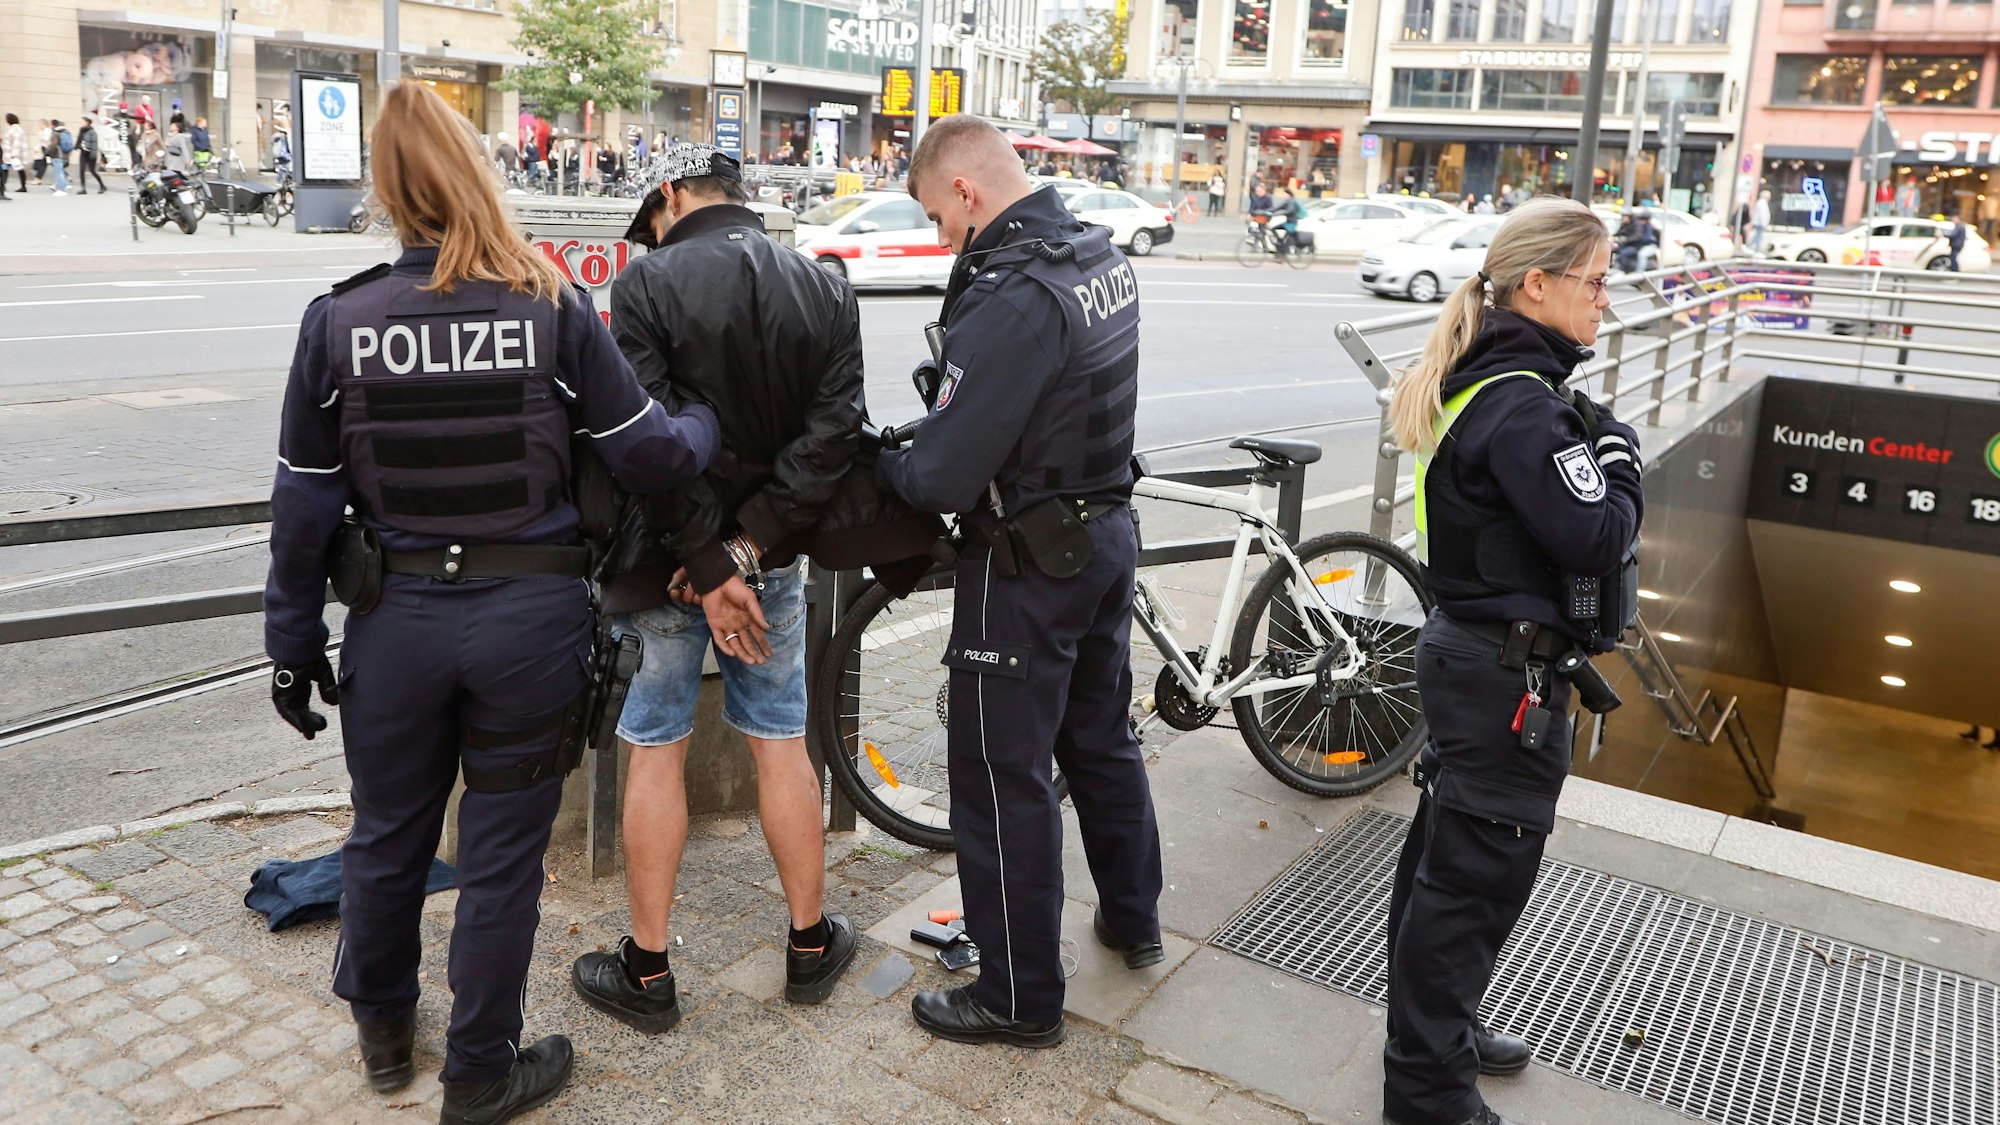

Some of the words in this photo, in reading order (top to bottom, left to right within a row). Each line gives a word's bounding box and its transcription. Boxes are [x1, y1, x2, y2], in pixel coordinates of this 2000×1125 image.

[1458, 51, 1569, 66] STARBUCKS
[320, 122, 345, 132] ZONE
[533, 240, 648, 287] Köl
[1073, 262, 1137, 328] POLIZEI
[351, 320, 536, 376] POLIZEI
[1773, 424, 1865, 453] Kunden
[1867, 437, 1954, 464] Center
[1790, 473, 1809, 493] 3
[1848, 482, 1868, 502] 4
[1906, 489, 1936, 512] 16
[1970, 498, 2000, 522] 18
[963, 649, 999, 664] POLIZEI
